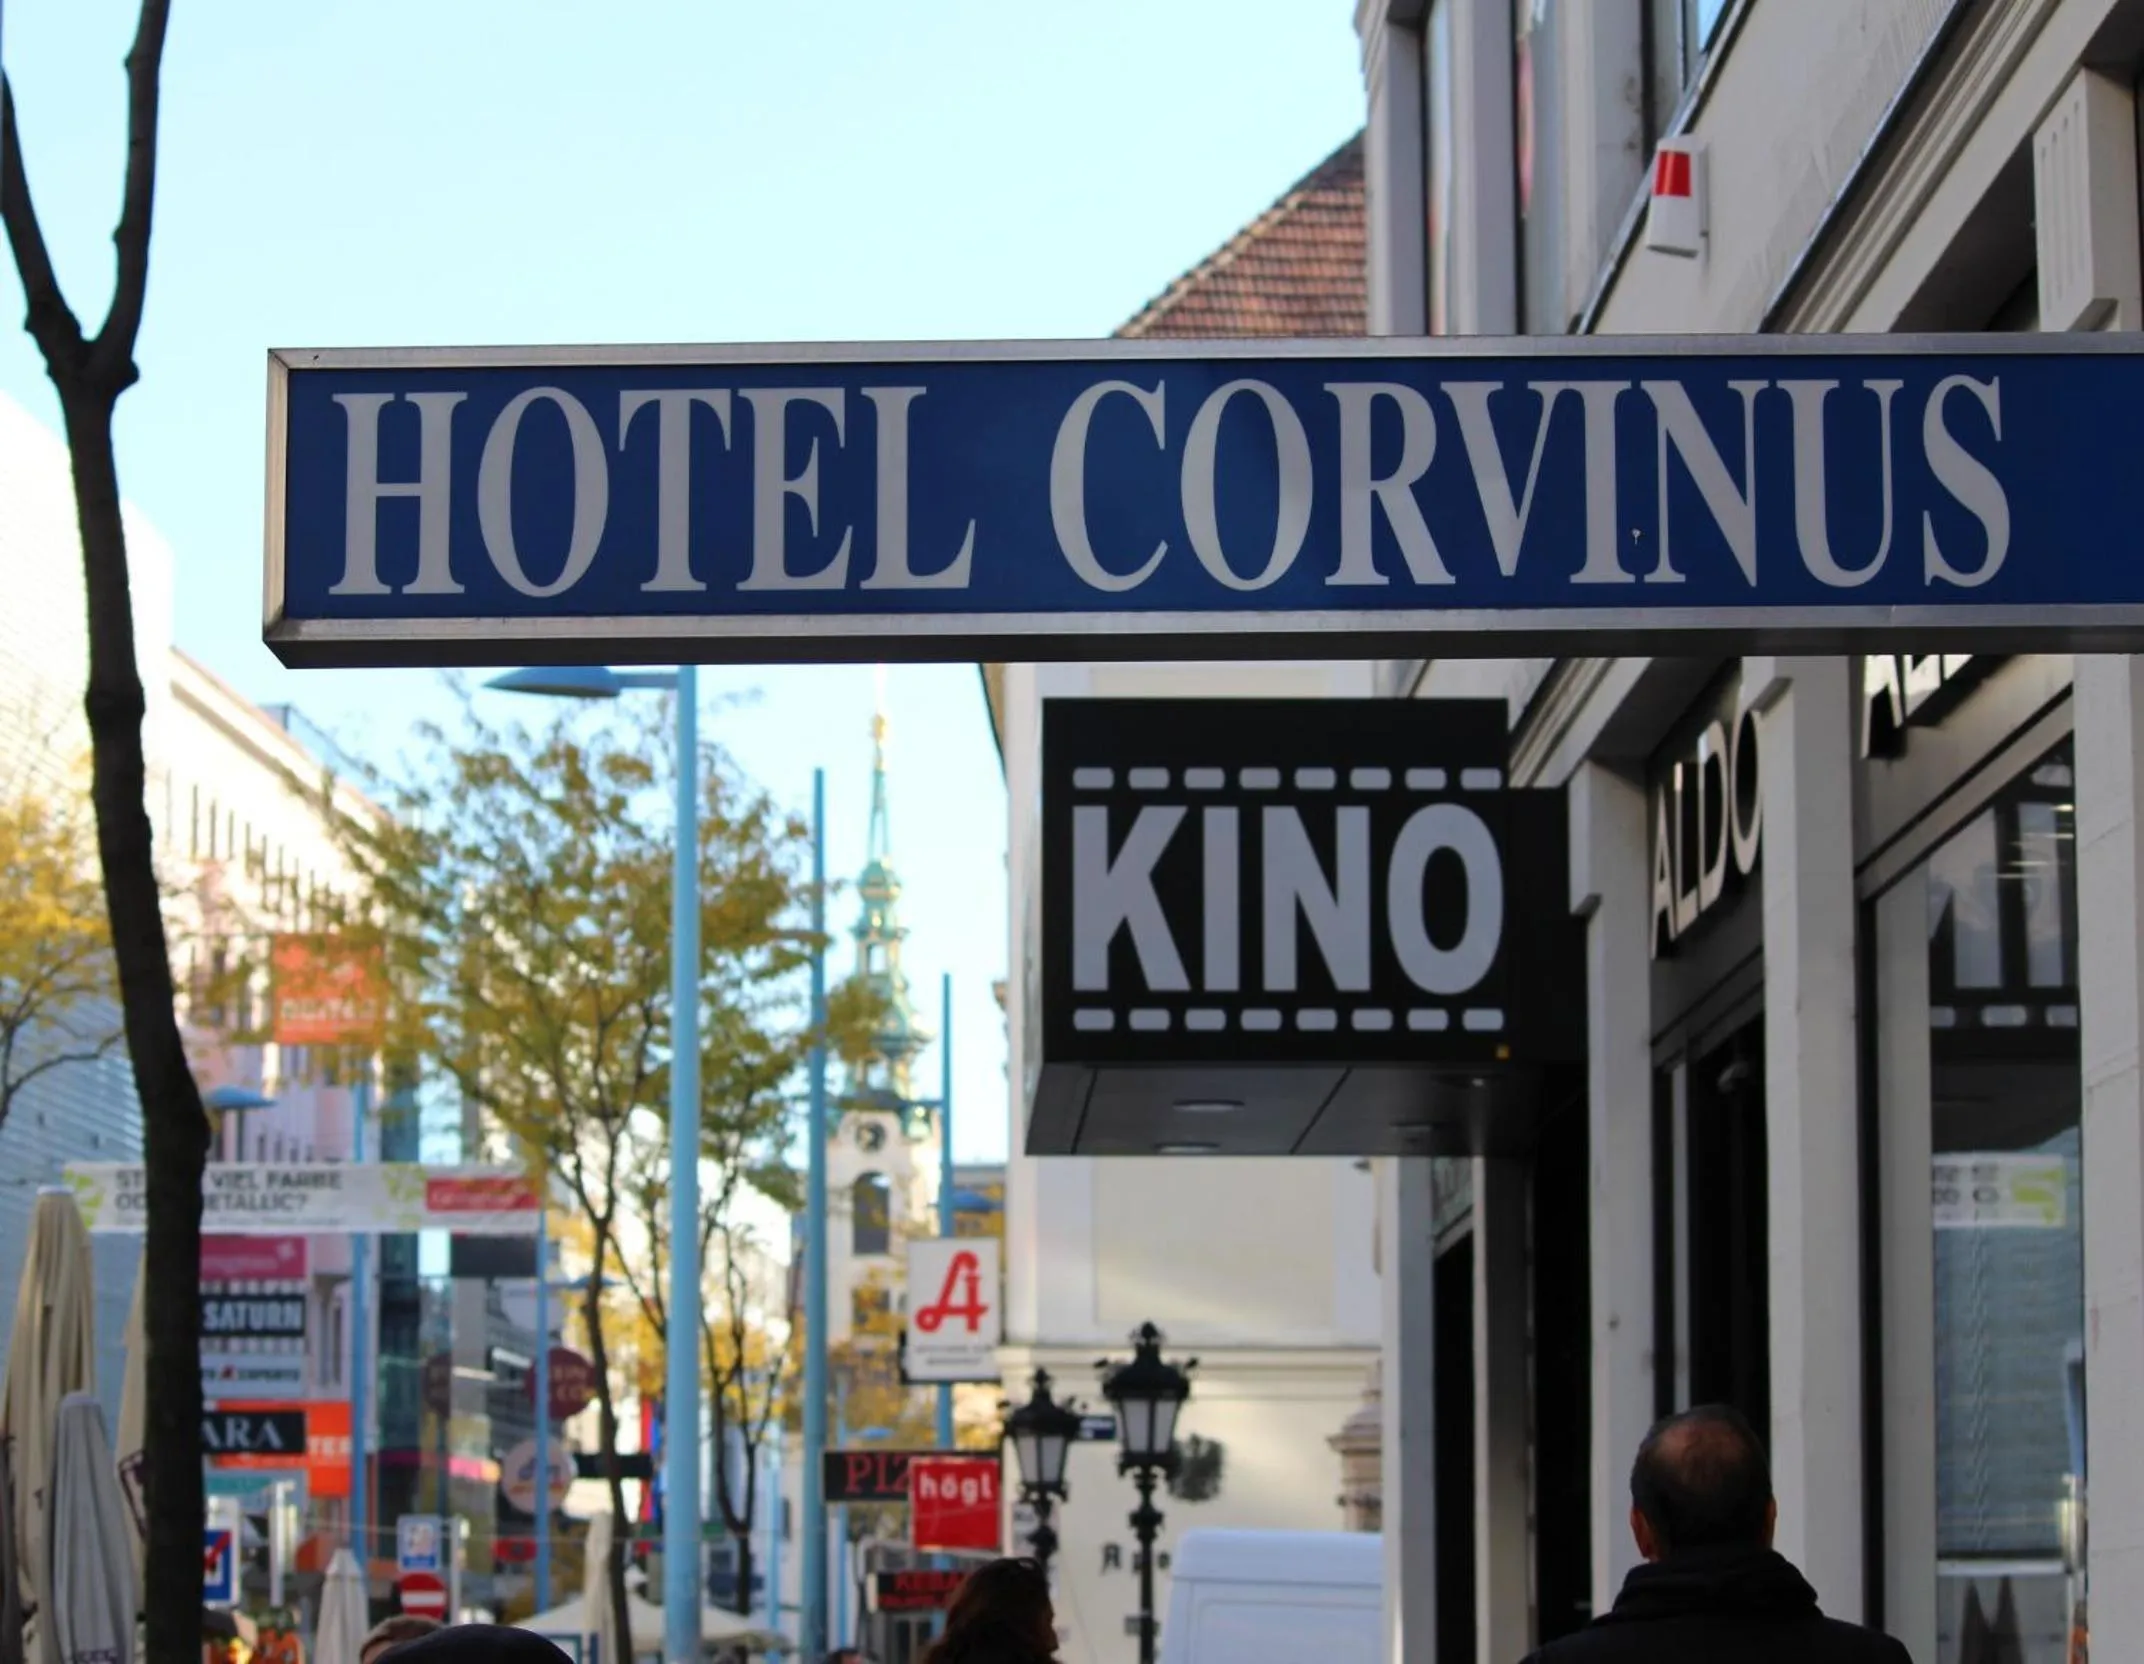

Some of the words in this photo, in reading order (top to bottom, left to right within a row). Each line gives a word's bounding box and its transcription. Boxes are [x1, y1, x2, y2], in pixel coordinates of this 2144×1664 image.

[328, 386, 975, 597] HOTEL
[1049, 374, 2010, 592] CORVINUS
[1652, 695, 1763, 960] ALDO
[1073, 803, 1503, 995] KINO
[203, 1193, 309, 1212] ETALLIC?
[202, 1301, 303, 1331] SATURN
[200, 1416, 283, 1449] ARA
[844, 1453, 912, 1495] PIZ
[919, 1470, 993, 1507] högl
